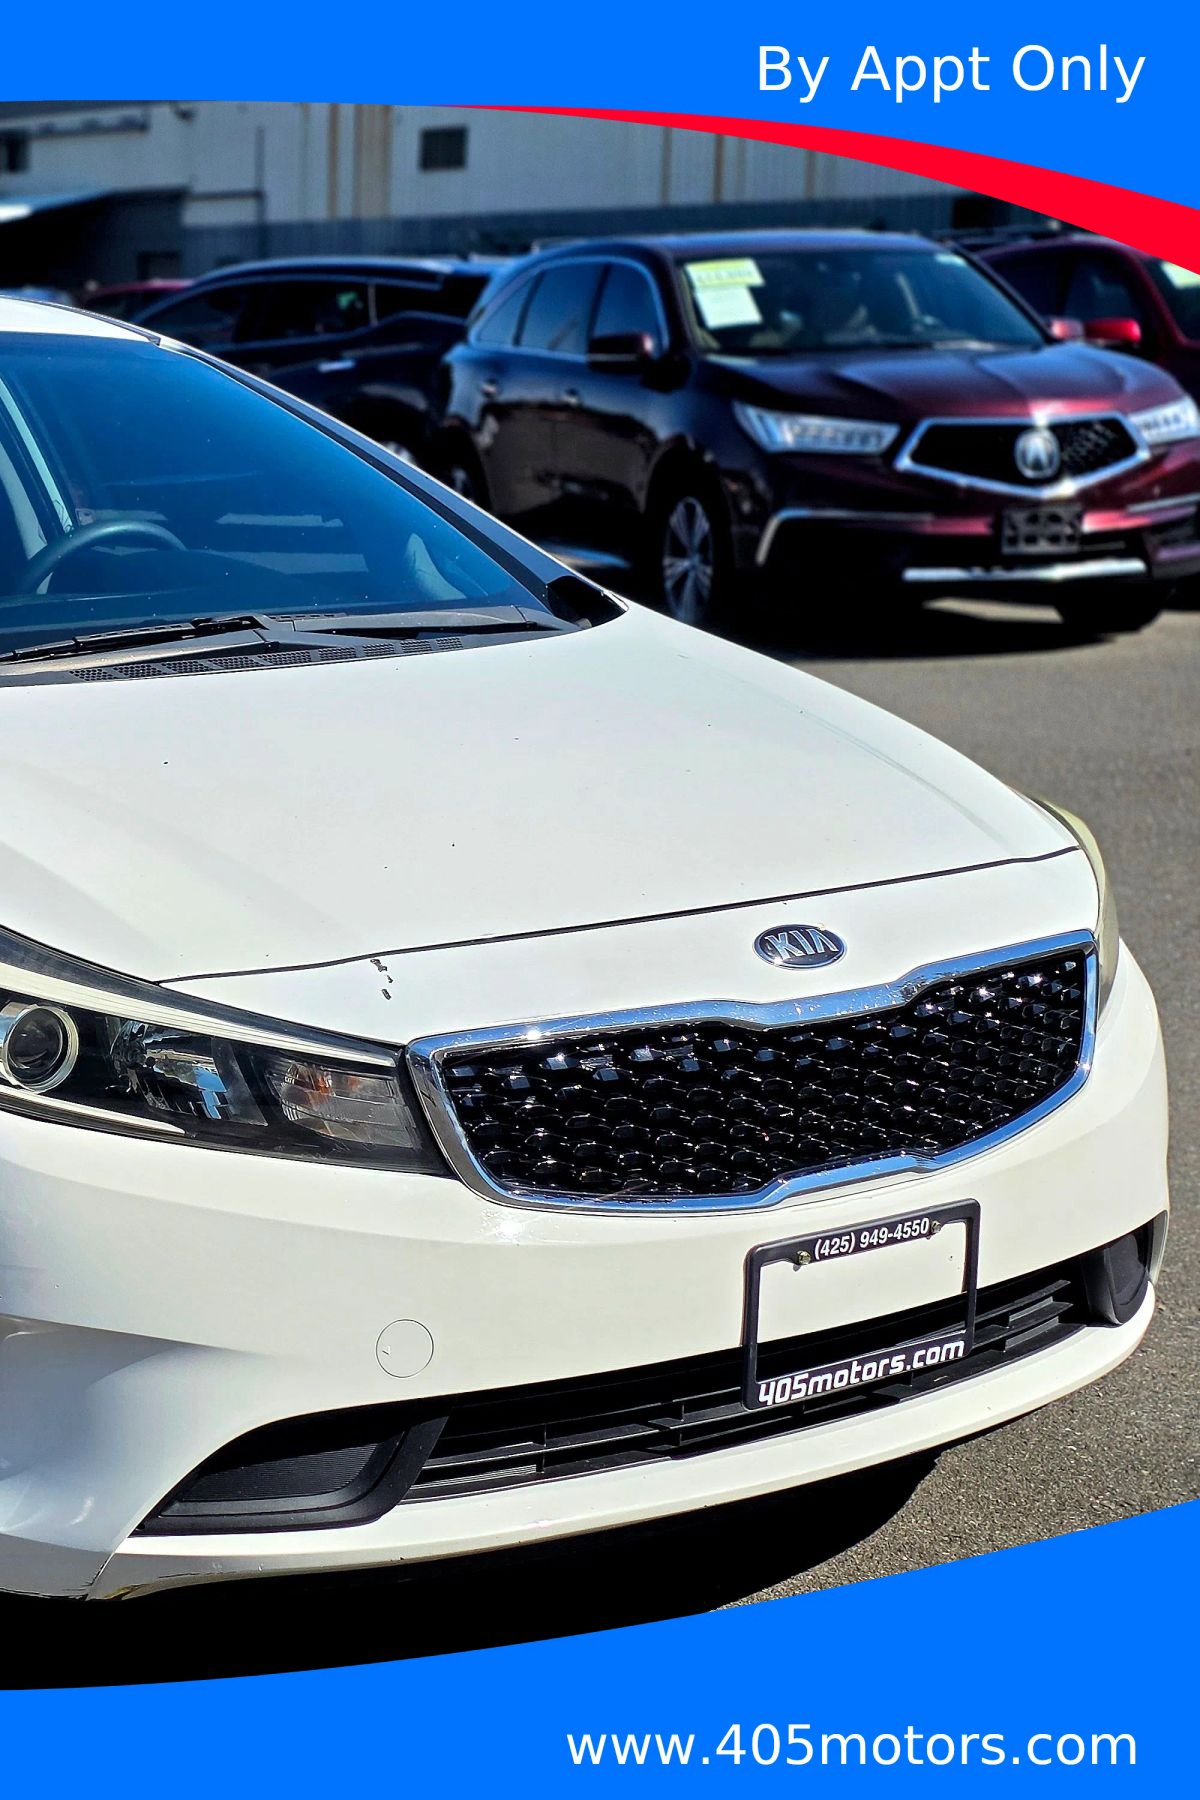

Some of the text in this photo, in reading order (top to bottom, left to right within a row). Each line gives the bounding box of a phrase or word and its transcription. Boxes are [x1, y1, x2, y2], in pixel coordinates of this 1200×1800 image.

[764, 928, 839, 961] KIA
[814, 1217, 930, 1260] (425) 949-4550
[758, 1340, 965, 1406] 405motors.com
